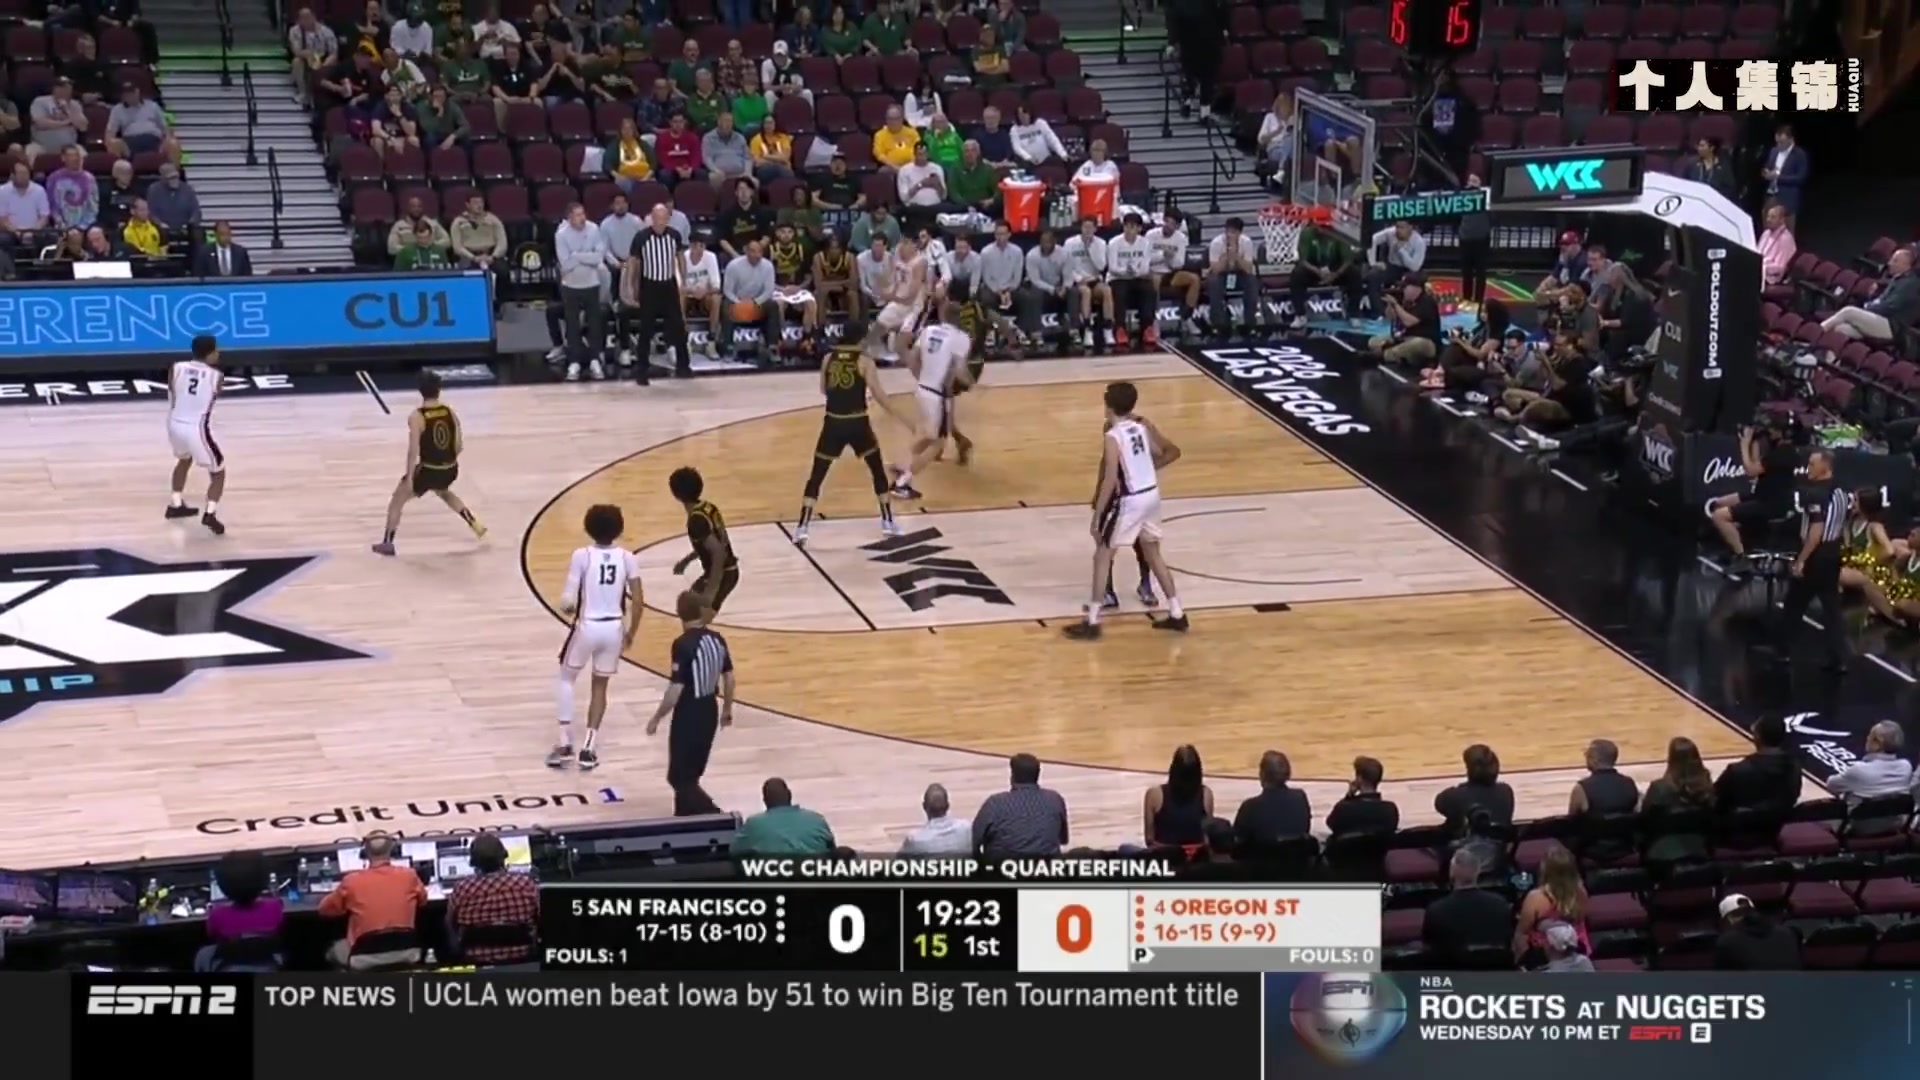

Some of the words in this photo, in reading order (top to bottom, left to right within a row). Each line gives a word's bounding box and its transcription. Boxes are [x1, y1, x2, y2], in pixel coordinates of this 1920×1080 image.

[1446, 1, 1470, 44] 15
[1526, 159, 1605, 192] WCC
[1387, 200, 1427, 217] RISE
[1434, 194, 1484, 213] WEST
[344, 291, 456, 329] CU1
[1253, 346, 1341, 379] 2026
[188, 377, 199, 395] 2
[1201, 348, 1284, 378] LAS
[1251, 377, 1371, 435] VEGAS
[600, 564, 617, 585] 13
[197, 805, 394, 836] Credit
[408, 792, 589, 818] Union
[598, 787, 624, 804] 1
